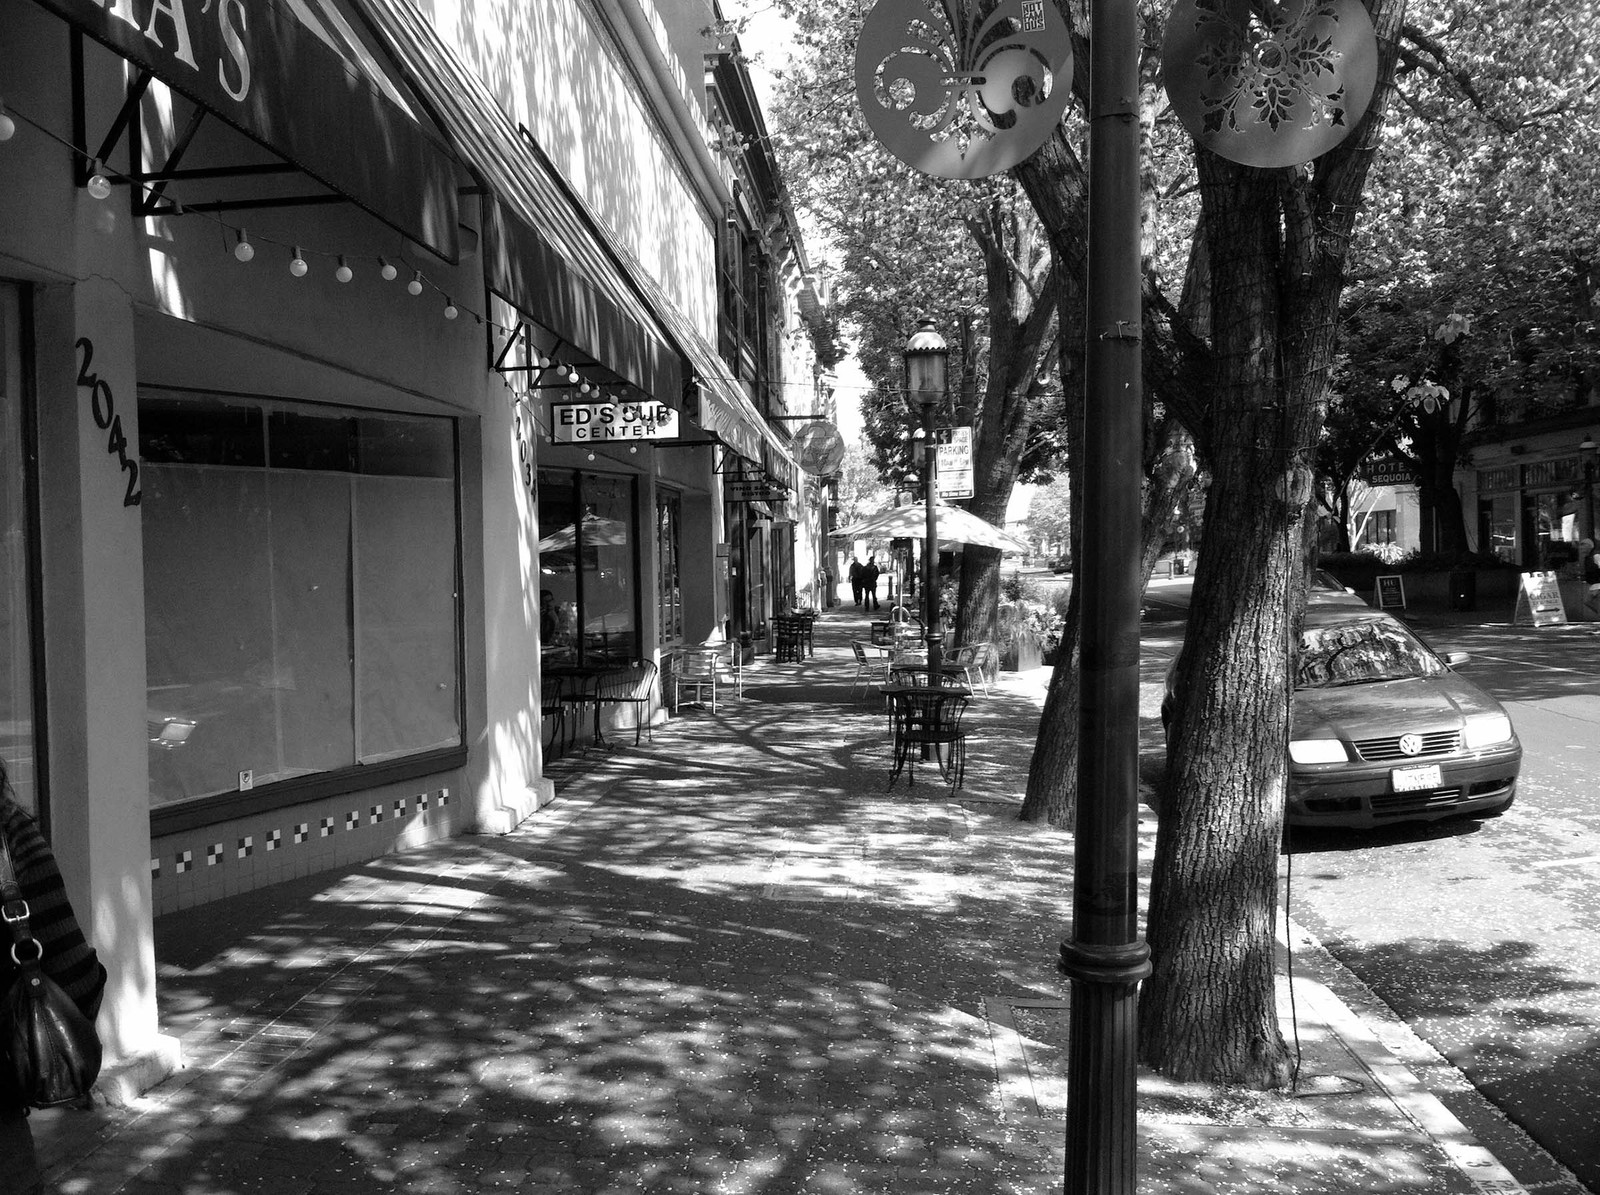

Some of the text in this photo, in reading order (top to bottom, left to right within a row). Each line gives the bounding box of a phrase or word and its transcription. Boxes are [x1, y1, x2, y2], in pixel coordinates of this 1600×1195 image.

[1022, 1, 1042, 13] NOT
[1024, 18, 1044, 31] OUS
[75, 337, 142, 507] 2042
[559, 406, 615, 426] ED'S
[576, 425, 655, 439] CENTER
[939, 445, 969, 456] PARKING
[1372, 473, 1411, 484] SEQUOIA
